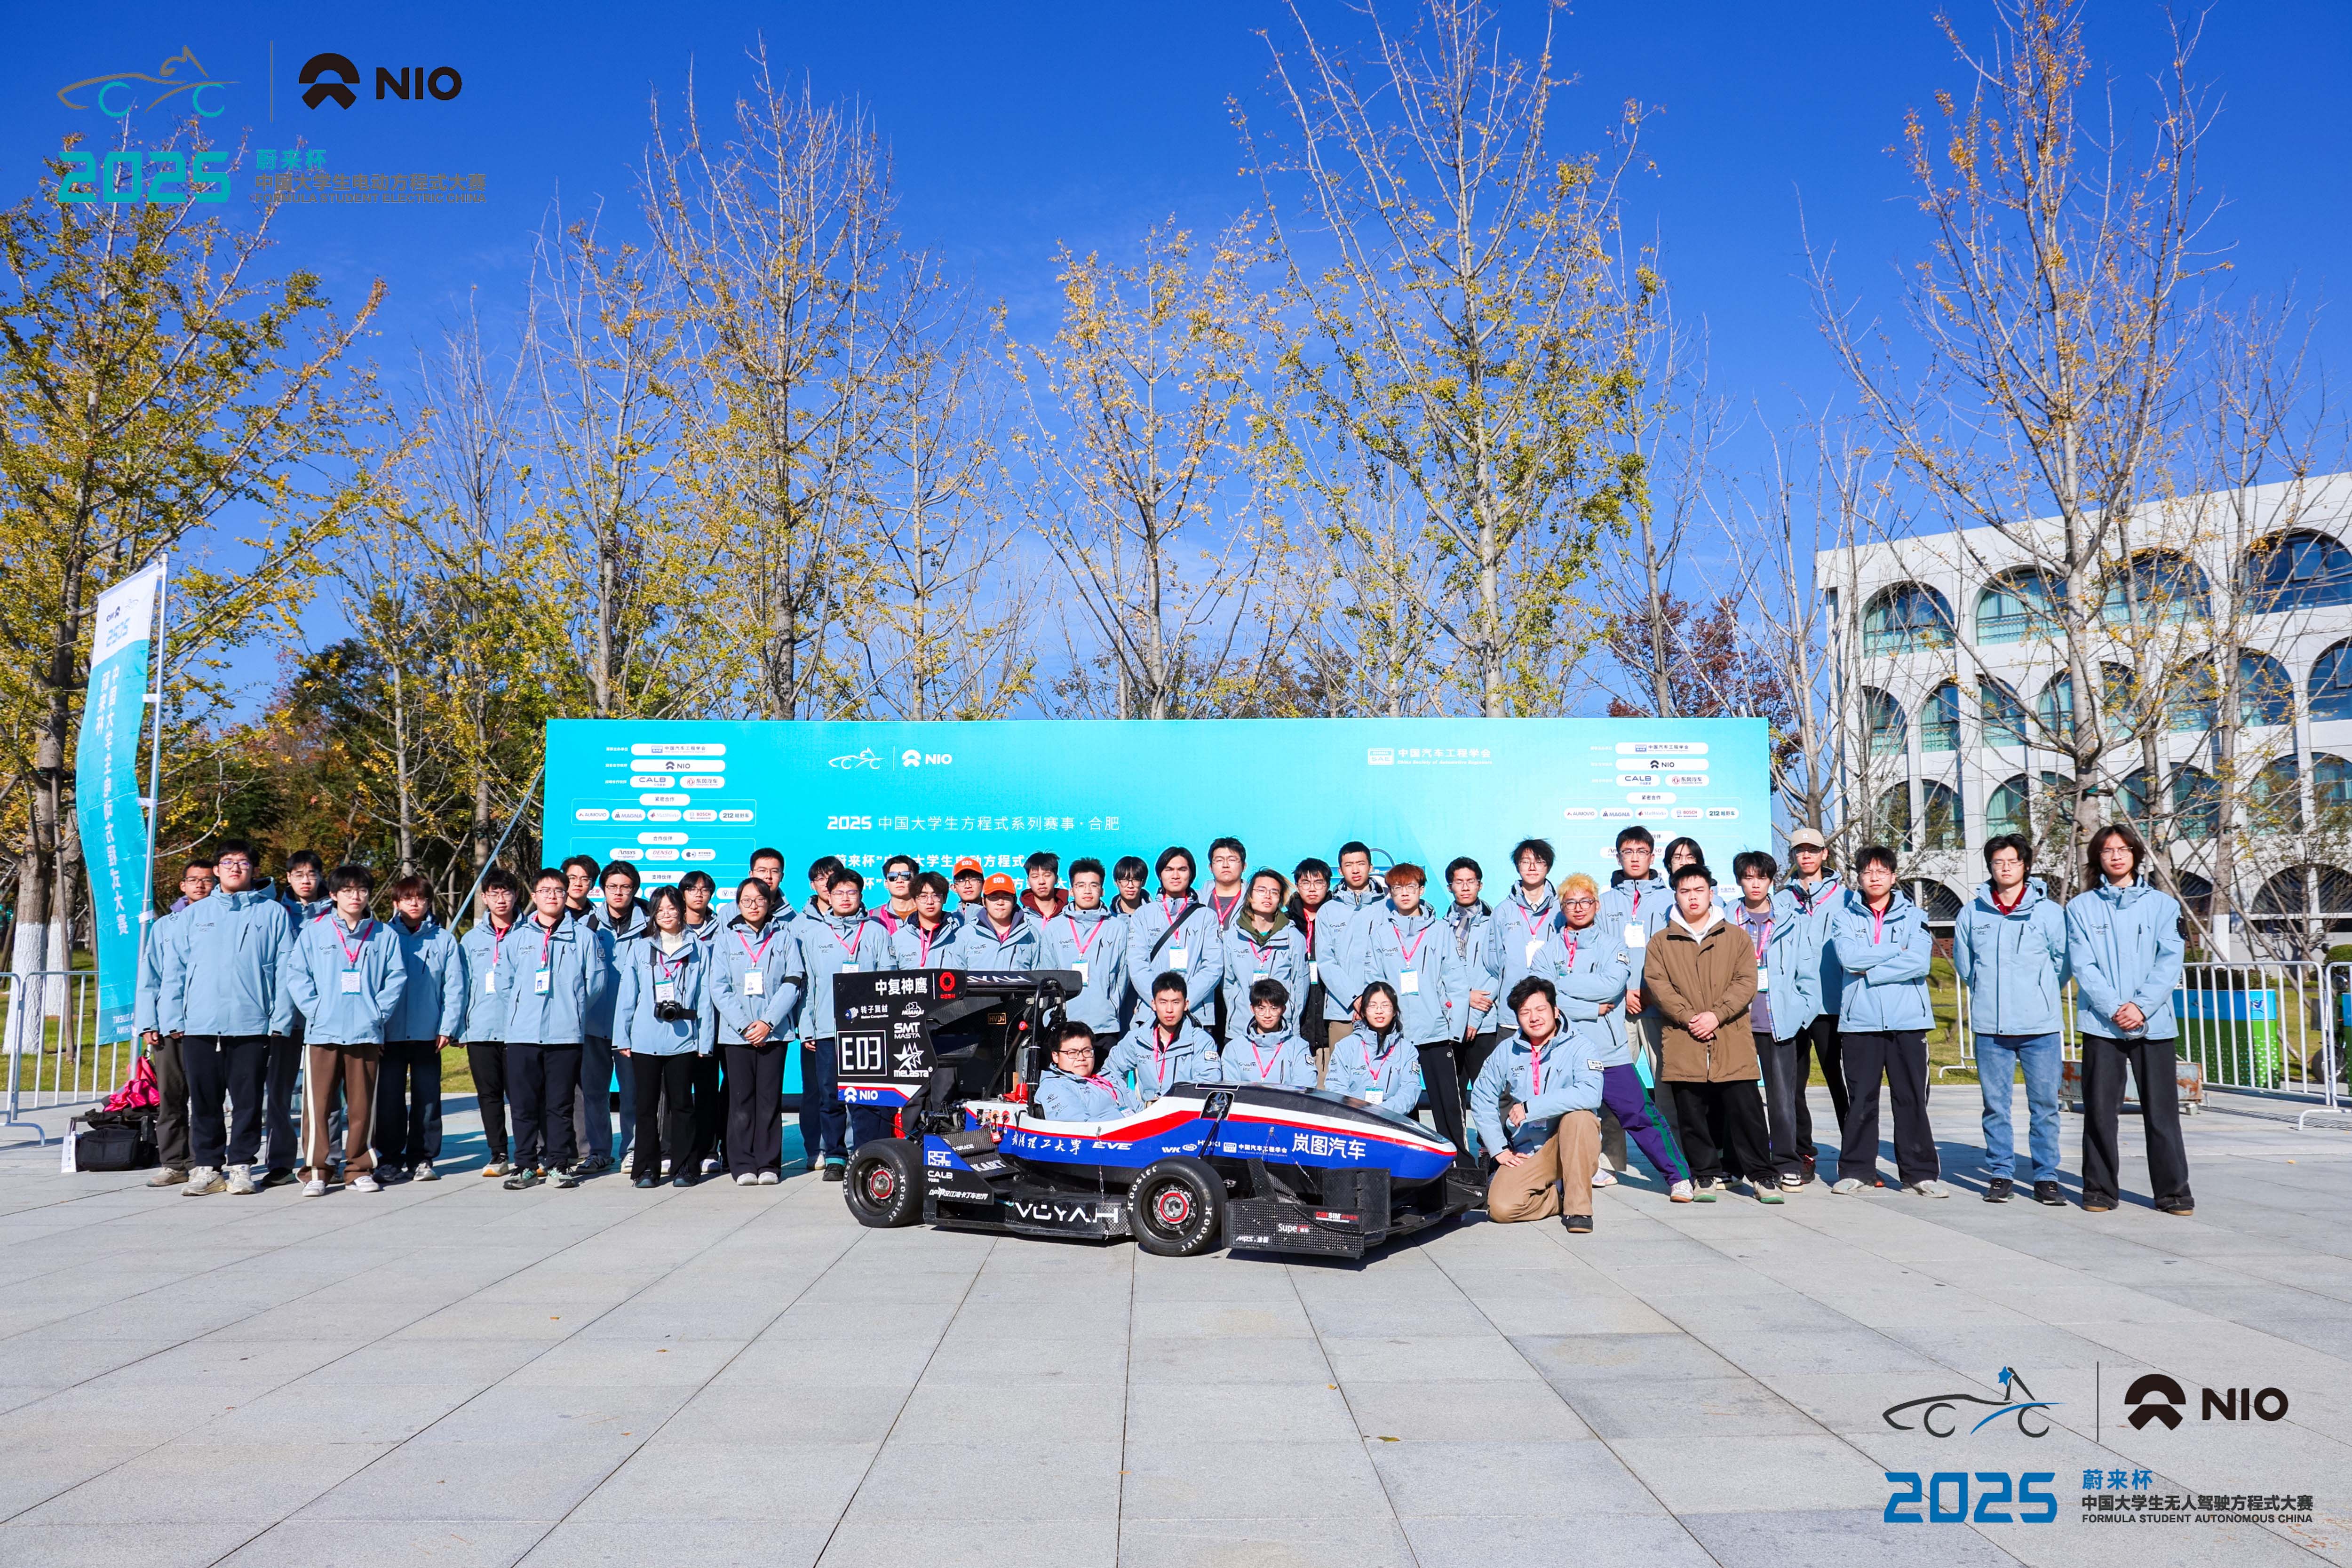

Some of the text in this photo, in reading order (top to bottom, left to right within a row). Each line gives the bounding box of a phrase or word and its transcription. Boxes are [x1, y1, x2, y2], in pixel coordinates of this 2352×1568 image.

[925, 754, 952, 765] NIO
[1398, 748, 1491, 758] 中国汽车工程学会
[827, 816, 872, 830] 2025
[875, 977, 928, 996] 中复神鹰
[860, 1004, 888, 1014] 转子复材
[894, 1022, 920, 1034] SMT
[842, 1037, 881, 1070] E03
[859, 1090, 878, 1100] NIO
[1092, 1141, 1133, 1150] EVE
[1239, 1144, 1287, 1154] 中国汽车工程学会
[1292, 1132, 1366, 1160] 岚图汽车
[970, 1160, 1006, 1171] KART
[843, 1149, 859, 1197] Hoosier
[928, 1170, 953, 1179] CALB
[1128, 1165, 1157, 1213] Hoosier
[889, 1174, 906, 1222] Hoosier
[1015, 1202, 1118, 1223] VOYAH
[1181, 1205, 1212, 1252] Hoosier
